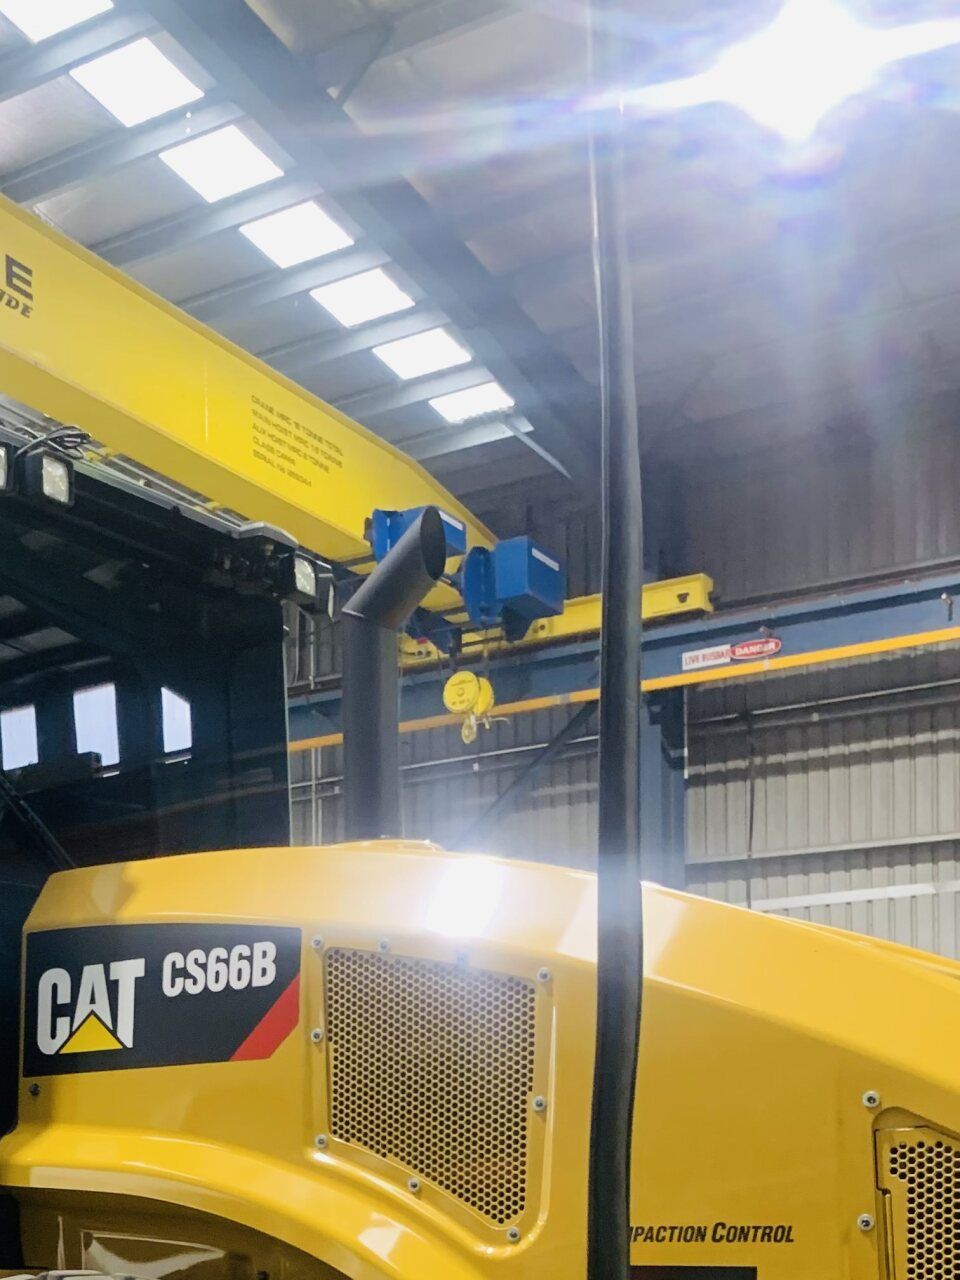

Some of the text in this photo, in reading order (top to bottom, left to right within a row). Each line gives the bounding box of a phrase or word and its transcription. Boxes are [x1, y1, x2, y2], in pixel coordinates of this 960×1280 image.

[735, 642, 776, 656] DANGER
[37, 941, 277, 1055] CAT CS66B
[630, 1222, 794, 1243] PACTION CONTROL
